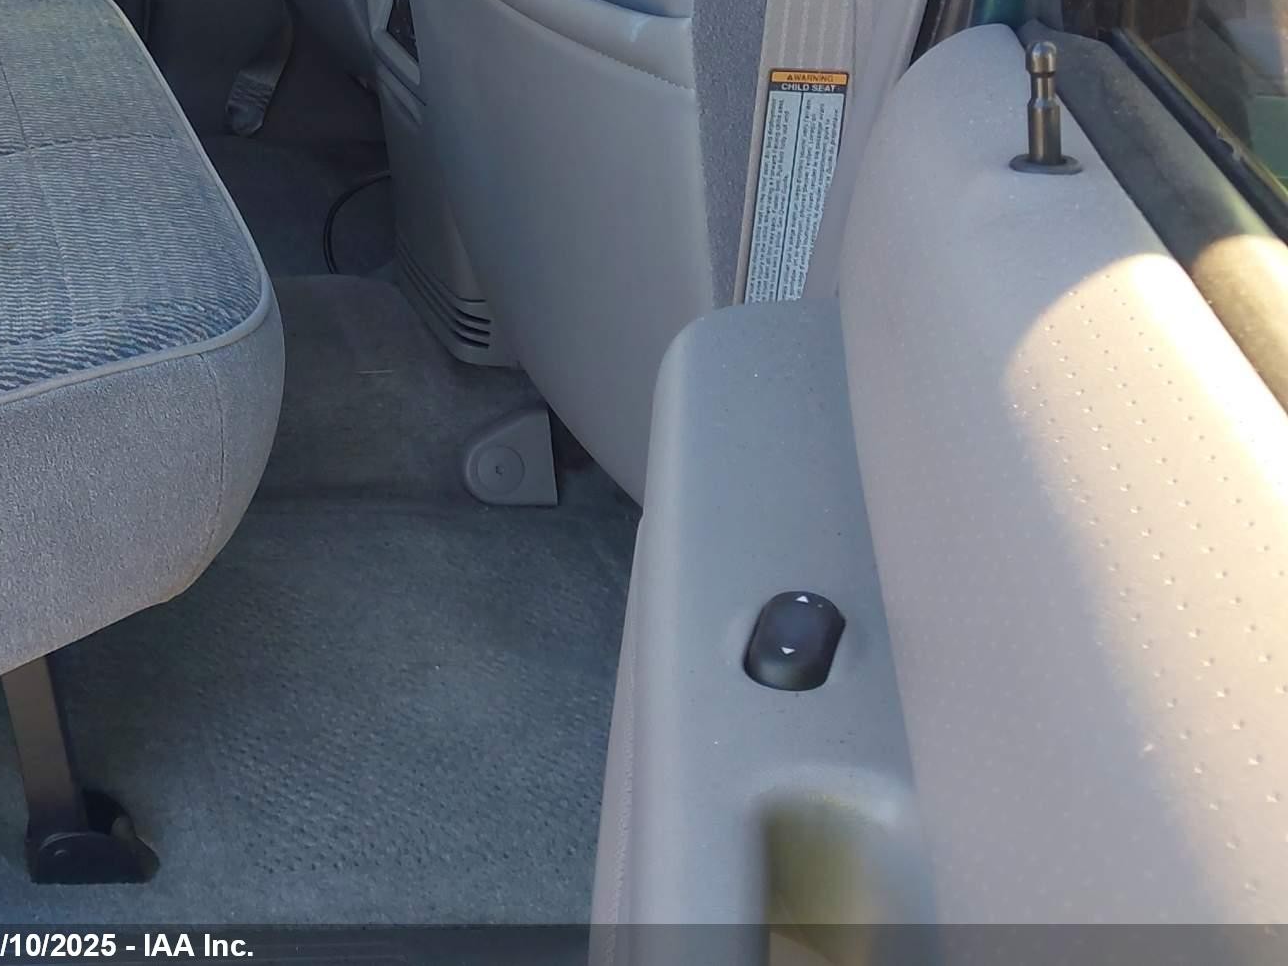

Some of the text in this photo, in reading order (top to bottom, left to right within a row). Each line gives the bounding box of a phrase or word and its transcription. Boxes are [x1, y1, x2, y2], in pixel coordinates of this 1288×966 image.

[794, 74, 834, 83] WARNING
[781, 83, 836, 93] CHILD SEAT
